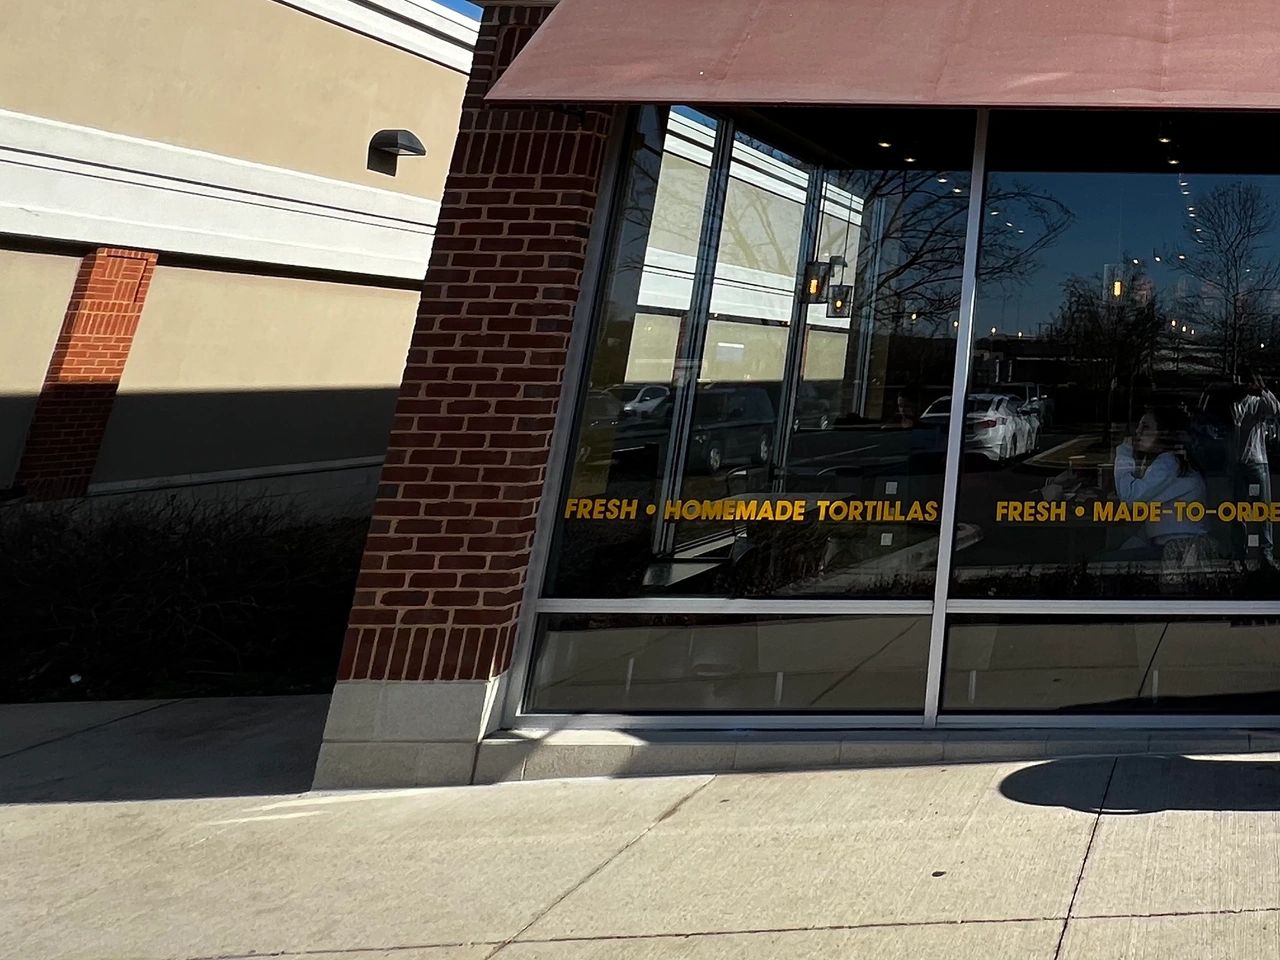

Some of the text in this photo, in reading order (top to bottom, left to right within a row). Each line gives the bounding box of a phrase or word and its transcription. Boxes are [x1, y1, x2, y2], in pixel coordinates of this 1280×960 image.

[564, 498, 939, 522] FRESH HOMEMADE TORTILLAS
[995, 501, 1067, 522] FRESH
